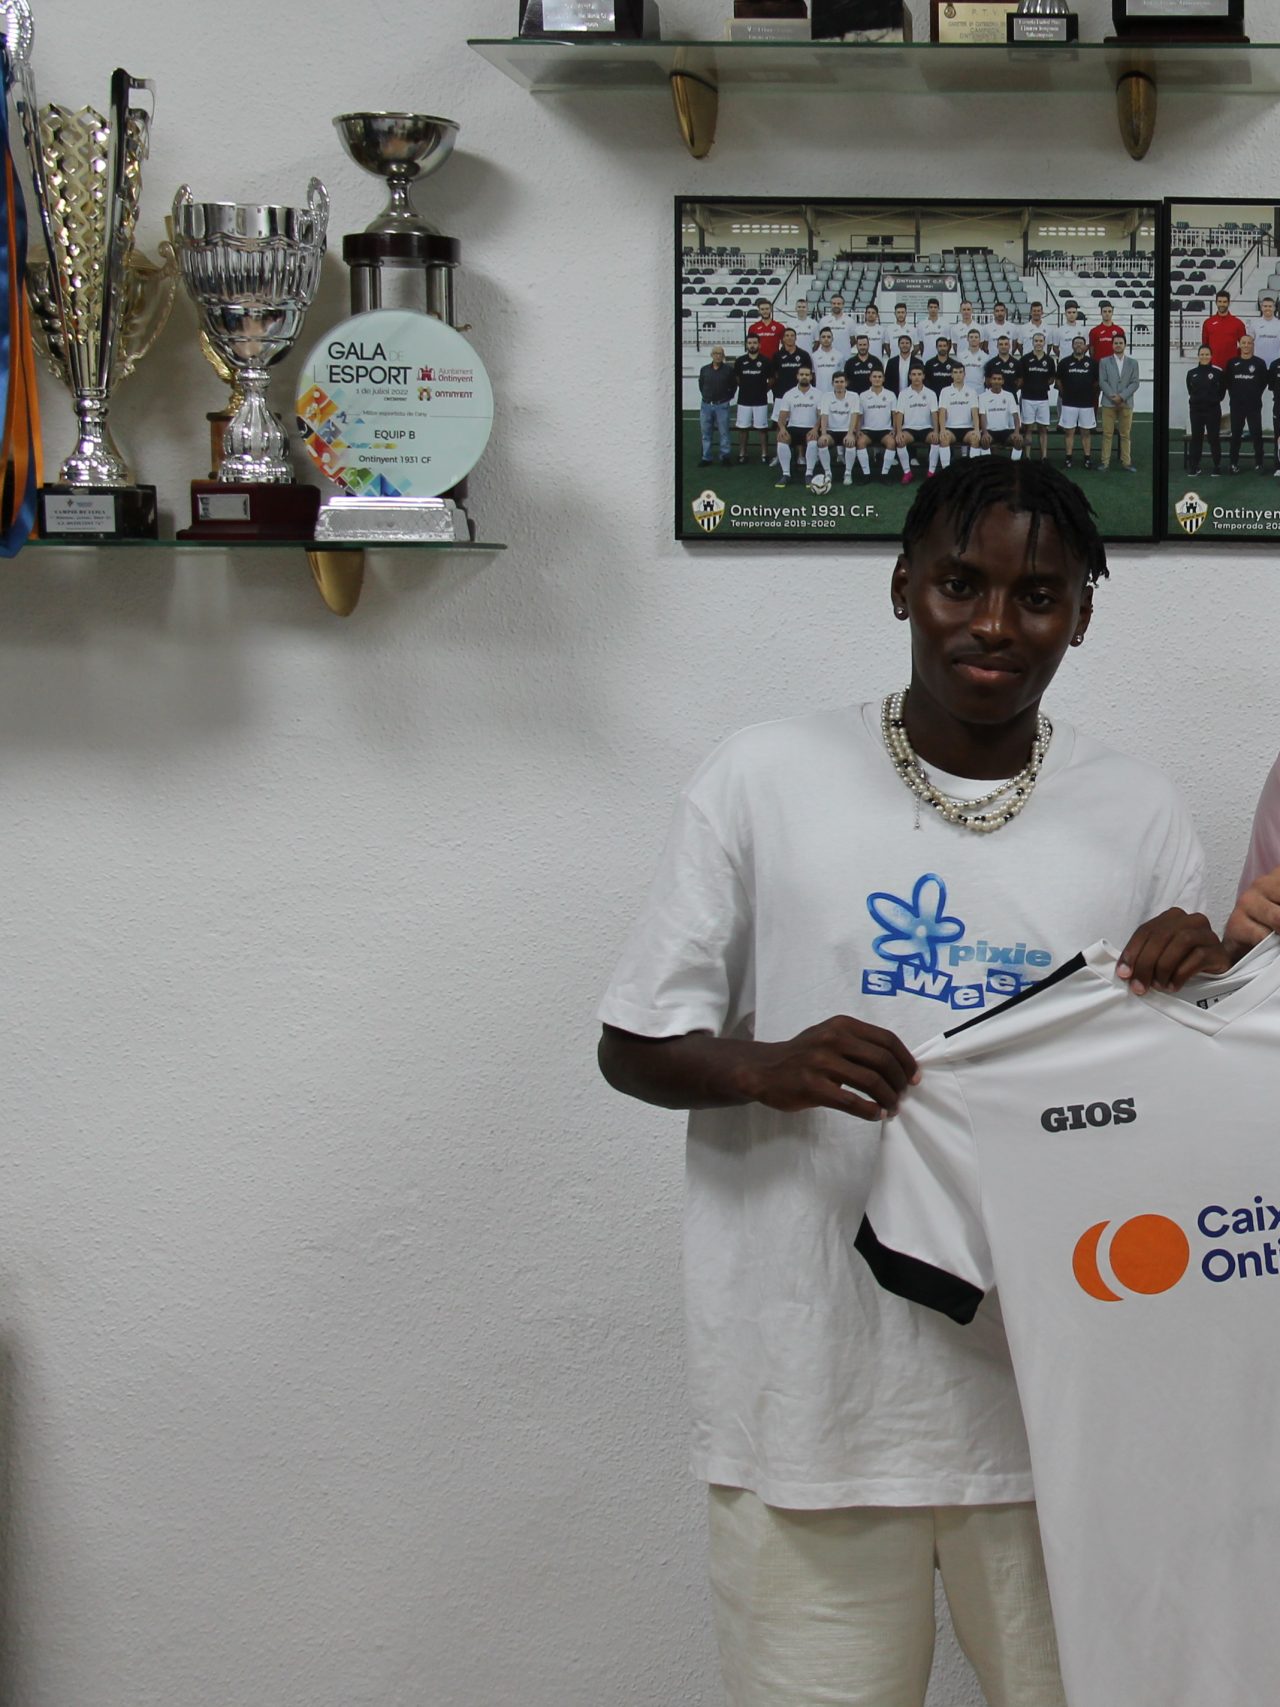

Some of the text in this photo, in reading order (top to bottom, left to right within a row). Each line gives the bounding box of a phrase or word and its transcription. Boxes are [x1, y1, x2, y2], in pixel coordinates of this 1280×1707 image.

[328, 342, 387, 361] GALA
[313, 365, 412, 384] L'ESPORT
[438, 367, 473, 376] Ajuntament
[438, 374, 473, 383] Ontinyent
[361, 387, 371, 395] de
[374, 430, 416, 440] EQUIP B
[358, 455, 431, 465] Ontinyent 1931 CF
[730, 504, 807, 519] Ontinyent
[811, 505, 845, 517] 1931
[850, 505, 879, 517] C.F.
[731, 520, 836, 528] Temporada 2019-2020
[1213, 522, 1264, 530] Temporada
[949, 940, 1052, 967] pixie
[862, 963, 1040, 1010] swee
[1040, 1098, 1138, 1132] GIOS
